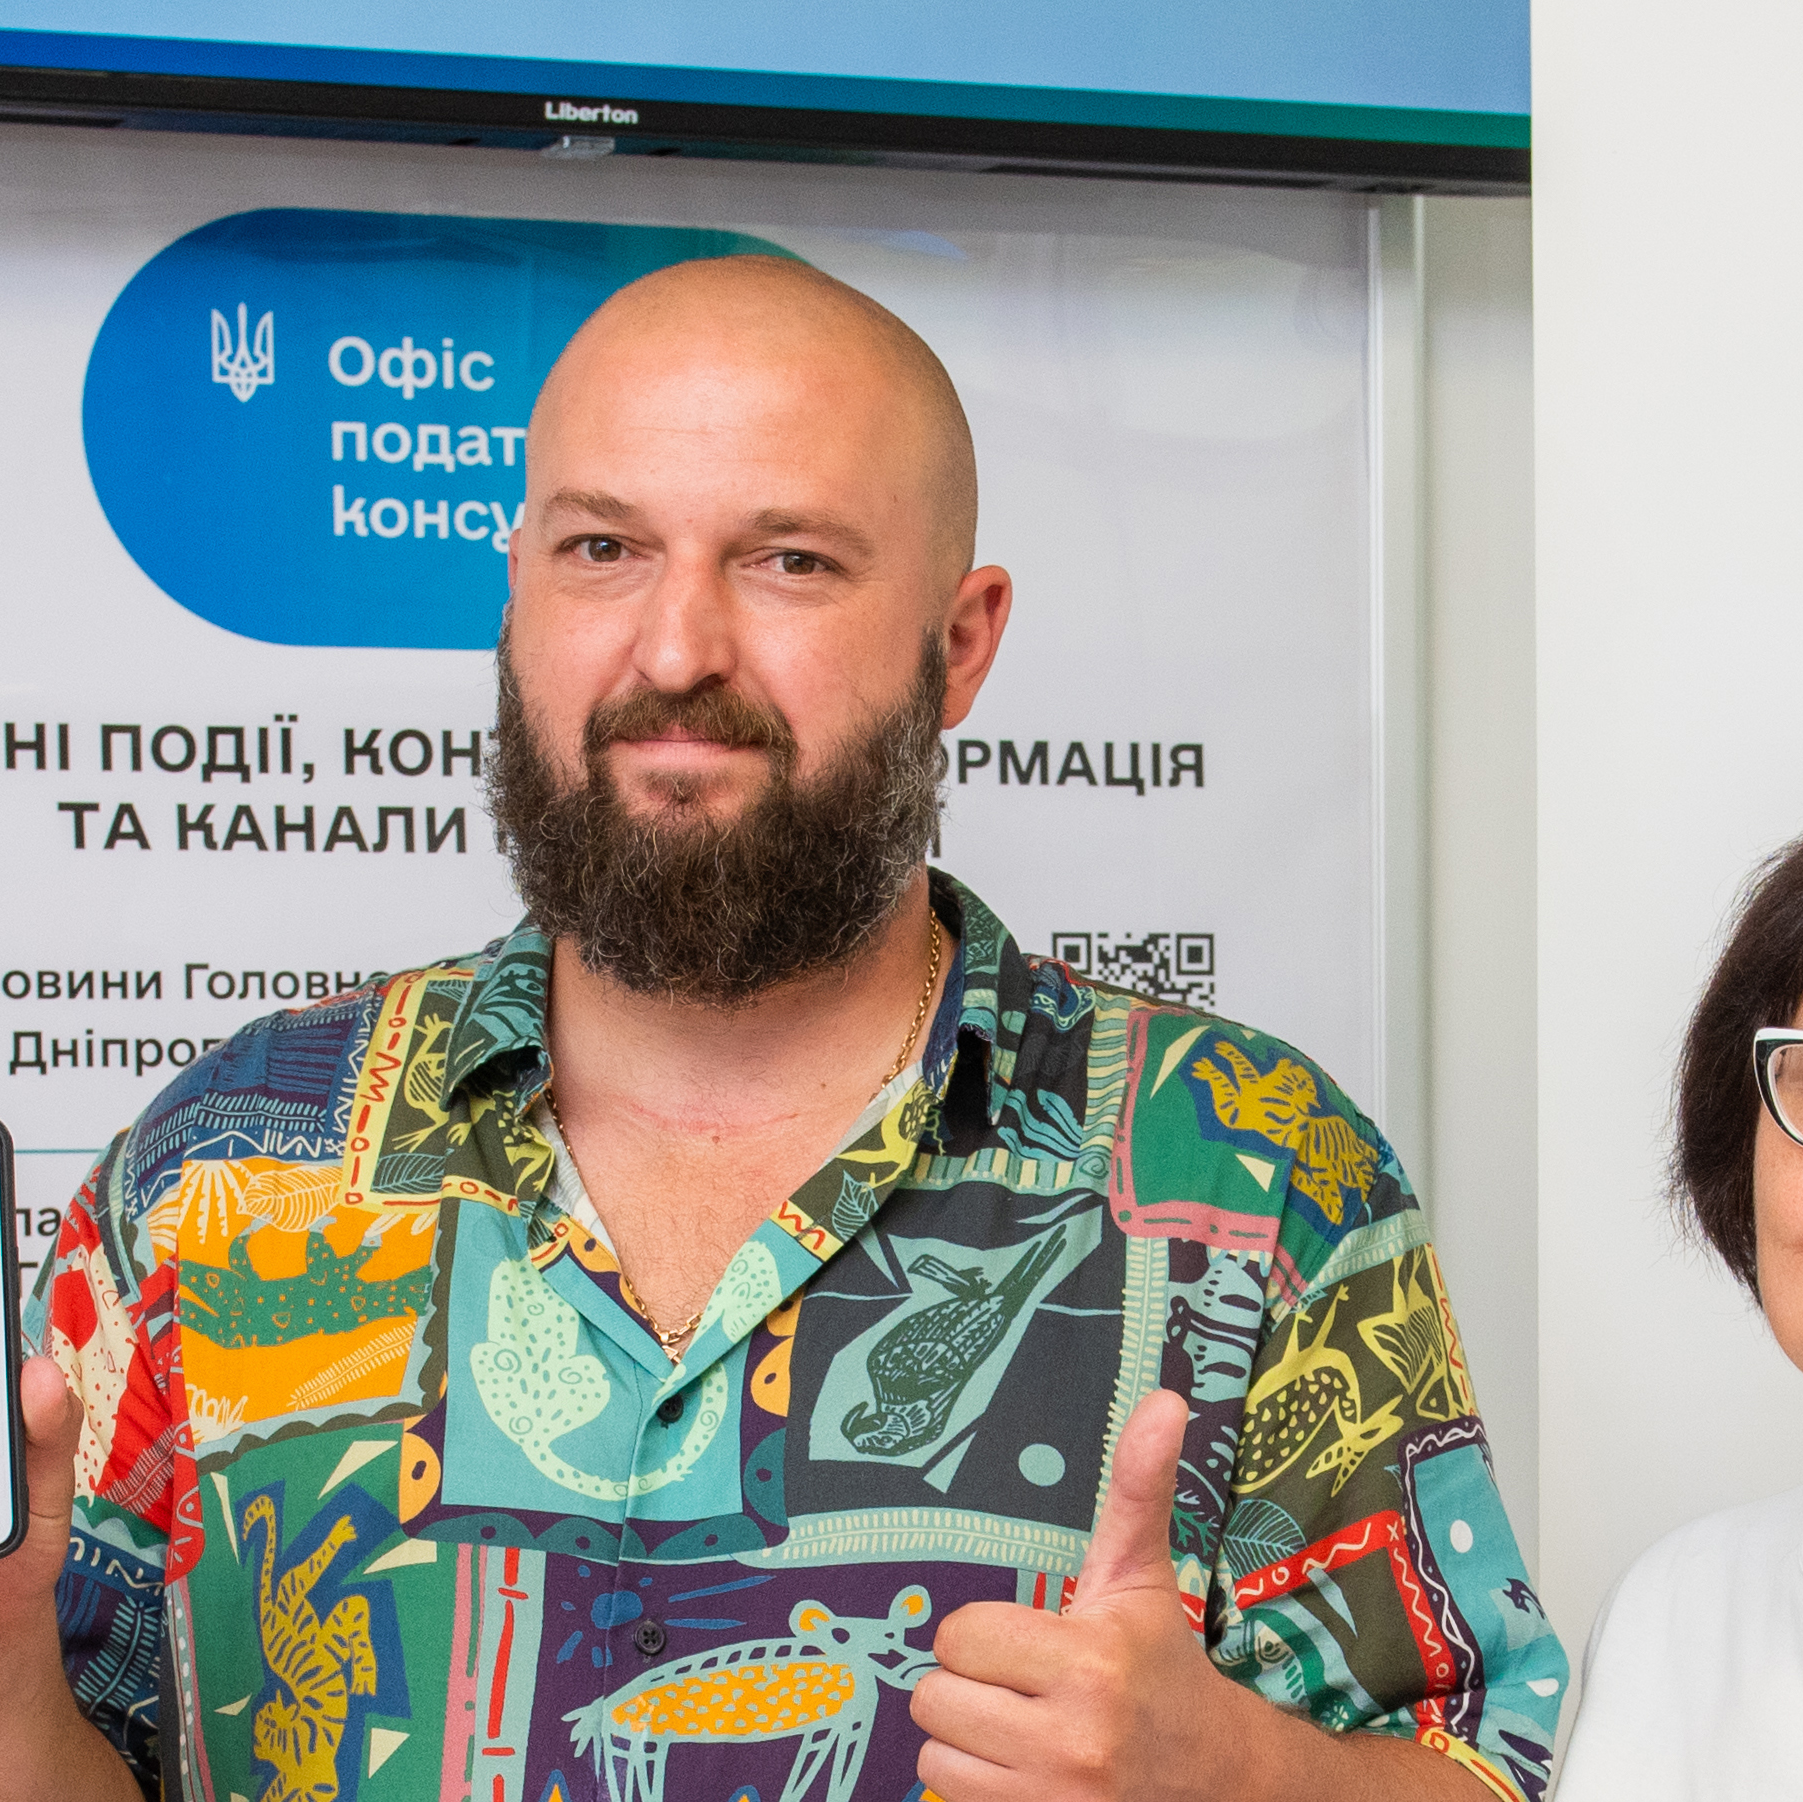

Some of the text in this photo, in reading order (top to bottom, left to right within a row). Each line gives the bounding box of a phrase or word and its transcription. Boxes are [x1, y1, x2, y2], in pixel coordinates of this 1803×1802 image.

[544, 101, 639, 125] Liberton
[328, 336, 495, 400] Офіс
[331, 421, 527, 473] подат
[100, 713, 315, 784] ПОДІЇ,
[938, 739, 1205, 797] РМАЦІЯ
[57, 801, 151, 850] ТА
[176, 803, 468, 854] КАНАЛИ
[8, 1028, 228, 1077] Дніпро
